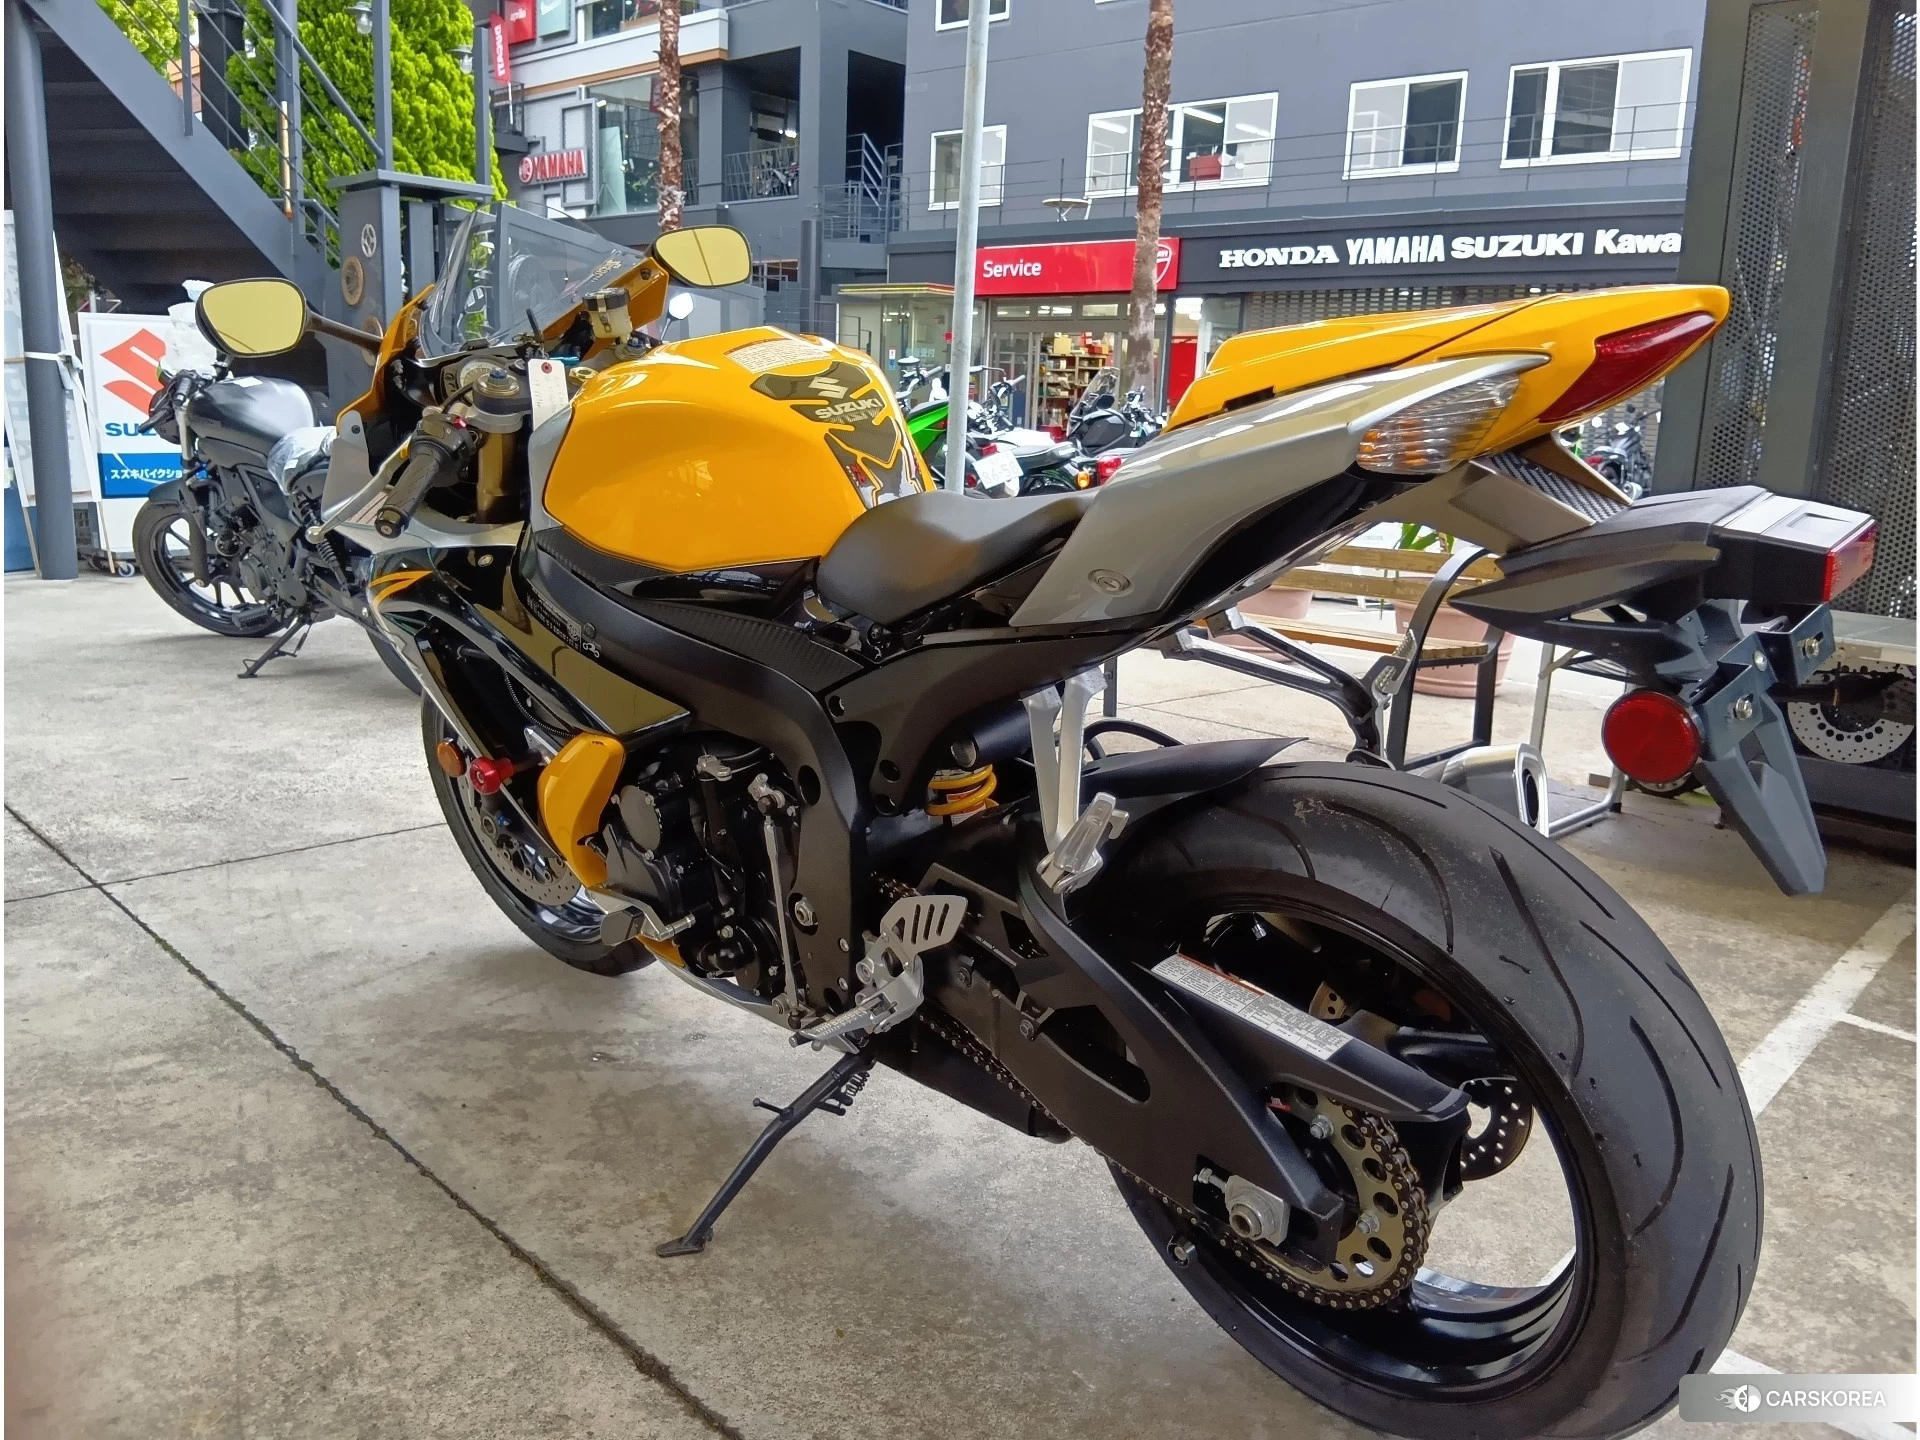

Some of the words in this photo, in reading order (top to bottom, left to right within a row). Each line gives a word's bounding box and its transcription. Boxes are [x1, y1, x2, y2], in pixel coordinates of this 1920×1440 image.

[532, 150, 587, 180] YAMAHA
[1218, 245, 1340, 268] HONDA
[1345, 234, 1446, 266] YAMAHA
[1450, 232, 1585, 259] SUZUKI
[1594, 228, 1682, 255] Kawa
[982, 259, 1042, 278] Service
[814, 398, 884, 419] SUZUKI
